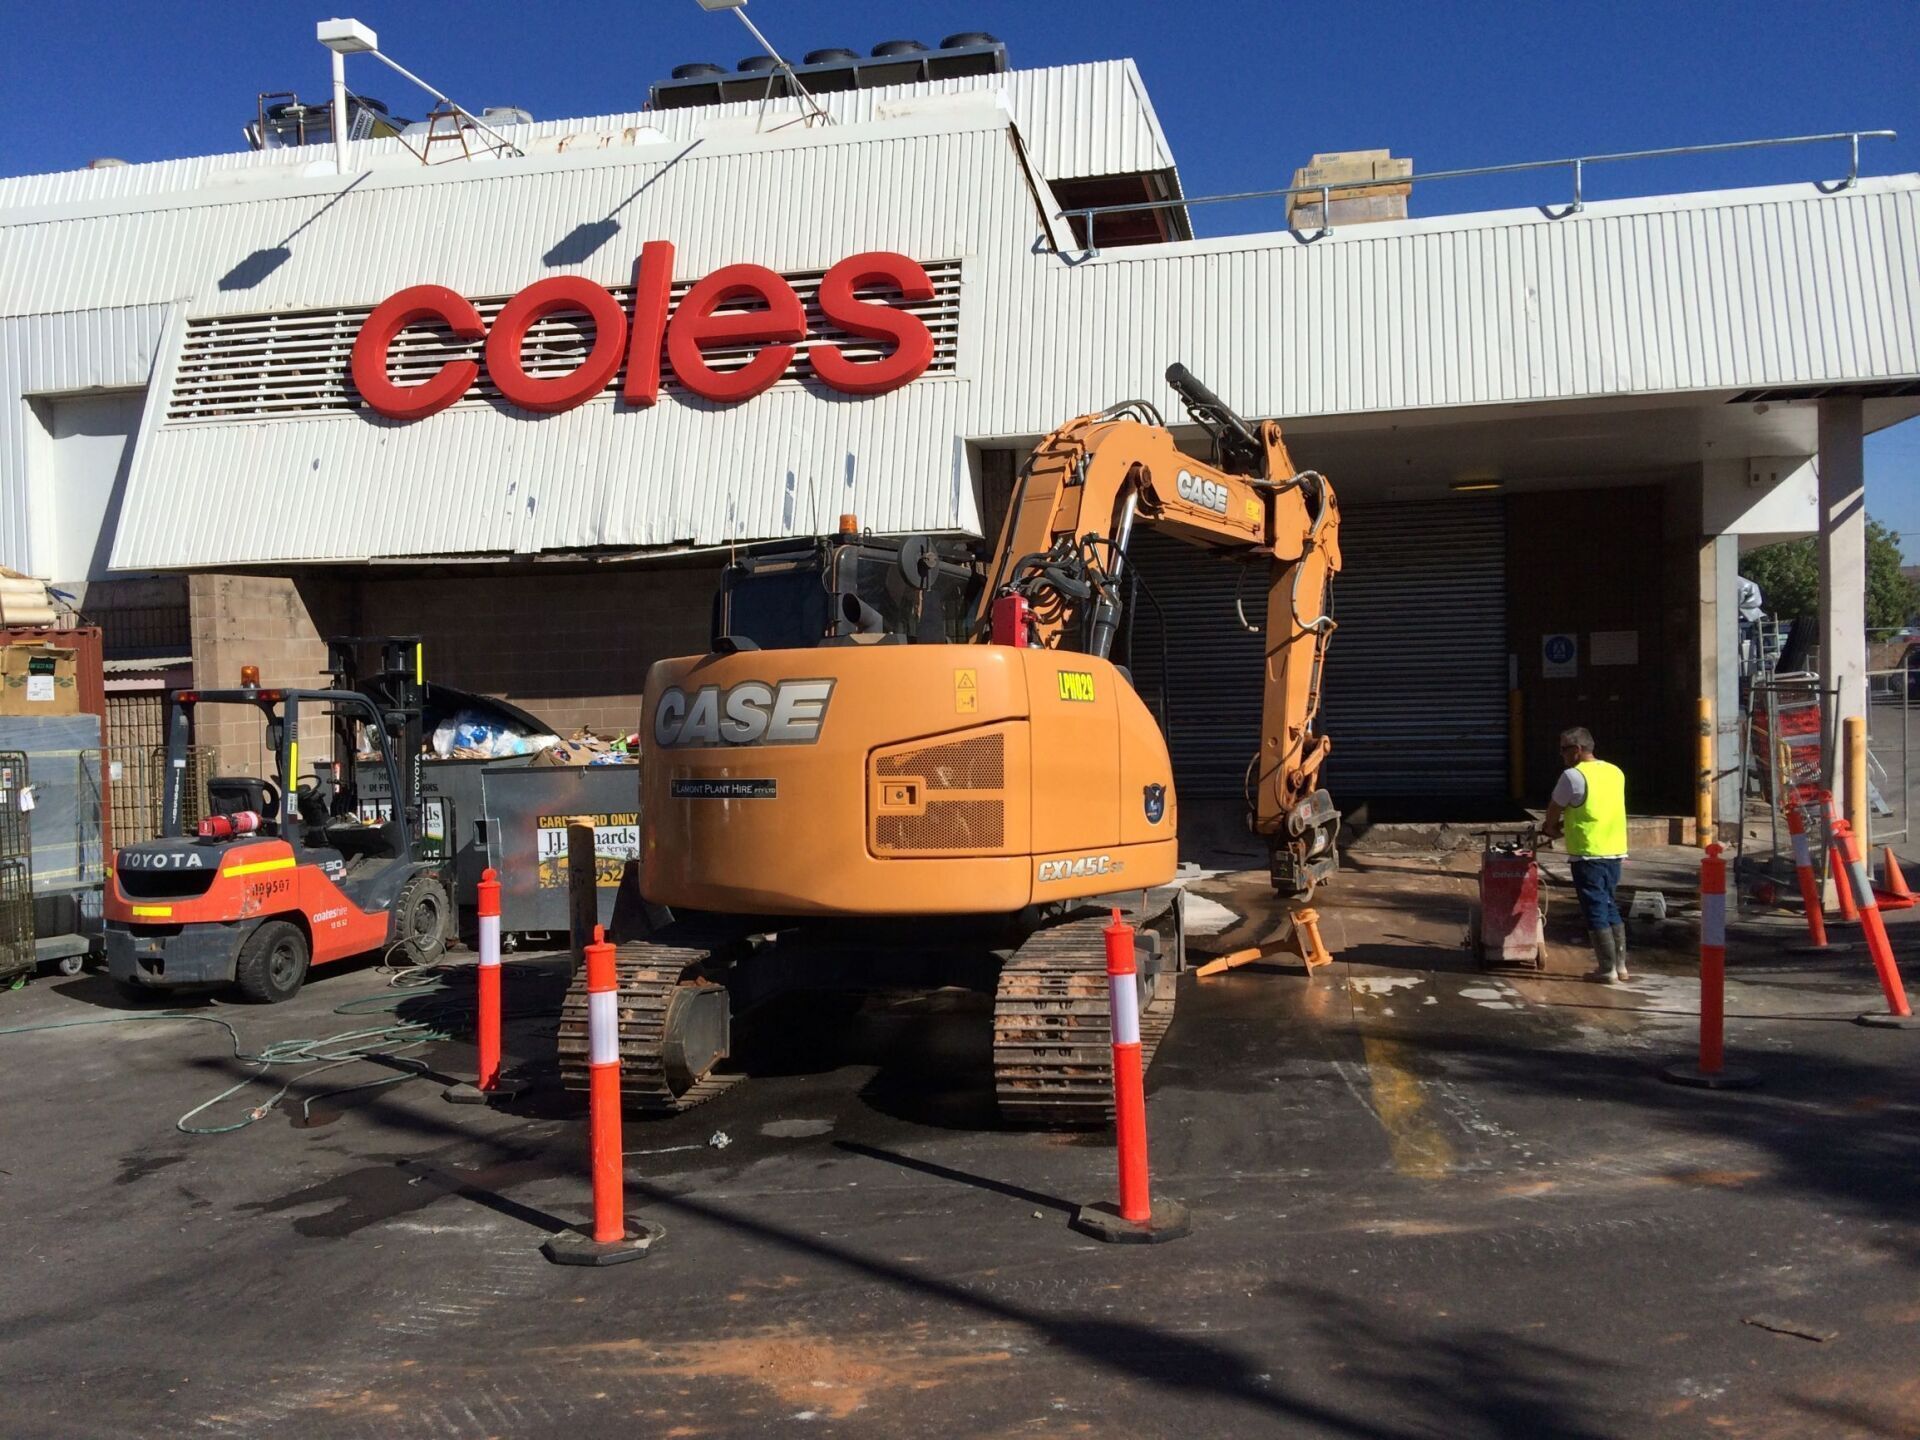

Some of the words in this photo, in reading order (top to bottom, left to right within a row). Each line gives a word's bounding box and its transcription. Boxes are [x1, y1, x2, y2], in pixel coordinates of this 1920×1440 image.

[351, 240, 935, 420] coles
[1177, 469, 1228, 514] CASE
[1058, 672, 1095, 701] LPH029
[655, 679, 836, 747] CASE
[676, 785, 703, 793] LAMONT
[704, 784, 730, 794] PLANT
[731, 784, 752, 794] HIRE
[610, 813, 638, 826] ONLY
[124, 852, 203, 868] TOYOTA
[1038, 855, 1110, 882] CX145C
